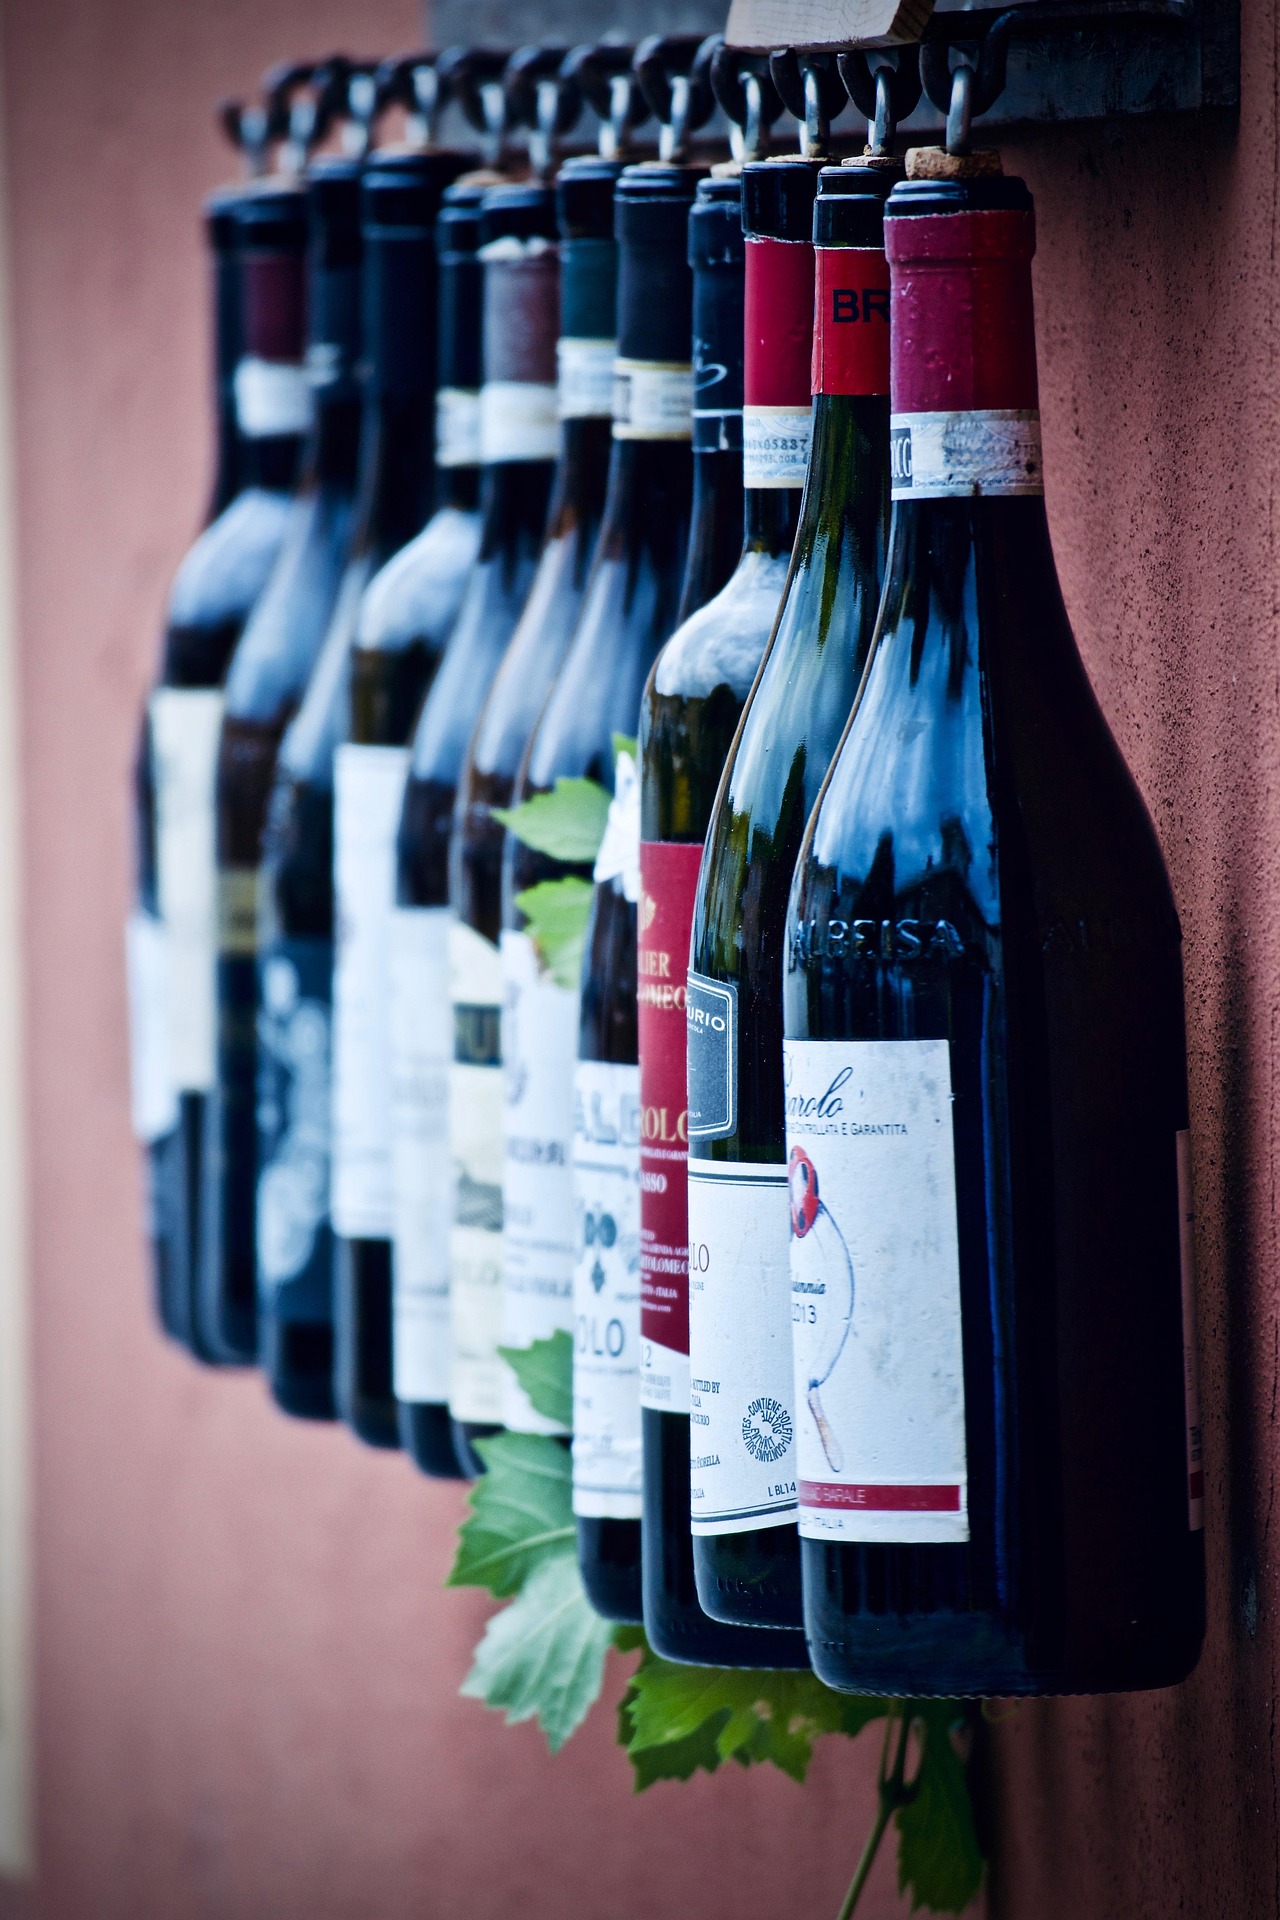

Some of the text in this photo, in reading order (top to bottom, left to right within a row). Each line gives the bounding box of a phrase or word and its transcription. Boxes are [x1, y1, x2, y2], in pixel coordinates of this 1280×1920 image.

[832, 288, 890, 323] BR
[851, 1122, 908, 1136] GARANTITA
[689, 1242, 709, 1273] LO
[712, 1382, 721, 1394] BY
[747, 1397, 793, 1444] CONTIENE SOLFITI
[742, 1417, 787, 1463] CONTAINS SULFITES
[767, 1487, 773, 1497] L
[775, 1481, 797, 1496] BL14
